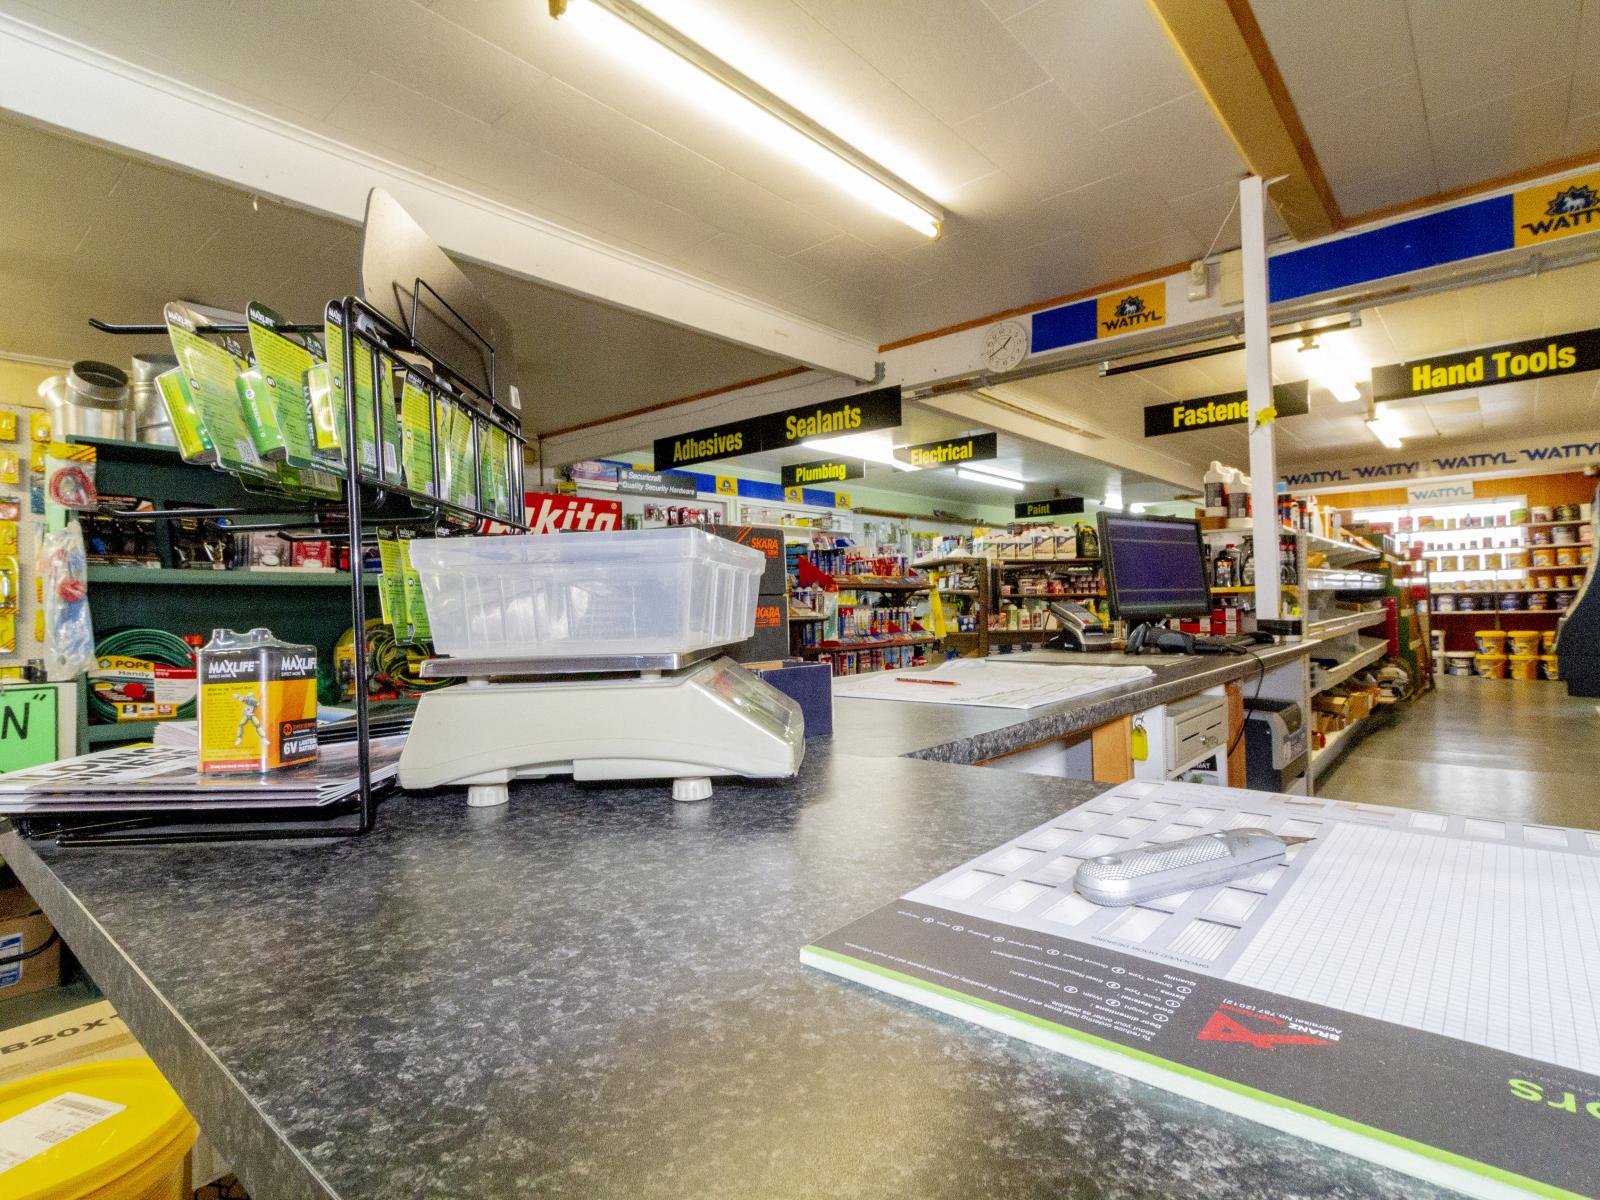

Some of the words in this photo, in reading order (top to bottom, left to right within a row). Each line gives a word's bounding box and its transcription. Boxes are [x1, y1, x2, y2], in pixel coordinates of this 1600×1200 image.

[1521, 209, 1600, 235] WATT
[1102, 310, 1162, 331] WATTYL
[1412, 356, 1484, 391] Hand
[1491, 344, 1576, 378] Tools
[1173, 400, 1248, 427] Fastene
[673, 431, 743, 462] Adhesives
[786, 405, 861, 439] Sealants
[911, 441, 973, 465] Electrical
[796, 463, 846, 482] Plumbing
[1281, 470, 1350, 485] WATTYL
[1432, 452, 1516, 469] WATTYL
[622, 481, 644, 490] Quality
[645, 483, 668, 493] Security
[669, 486, 695, 495] Hardware
[1409, 486, 1472, 500] WATTYL
[1027, 504, 1050, 515] Paint
[751, 537, 778, 549] SKARA
[115, 660, 150, 669] POPE
[209, 660, 255, 678] MAXLIFE
[118, 670, 150, 678] Handy
[284, 740, 298, 754] 6V
[1163, 974, 1196, 985] Quantity
[1120, 995, 1152, 1006] Material
[1159, 990, 1185, 999] Extras
[1123, 1004, 1149, 1014] Height
[1080, 1015, 1112, 1026] ordering
[1140, 1019, 1161, 1027] Door
[1295, 1018, 1343, 1034] Appraisal
[1113, 1026, 1140, 1036] reduce
[1132, 1026, 1155, 1035] about
[1288, 1022, 1341, 1041] BRANZ
